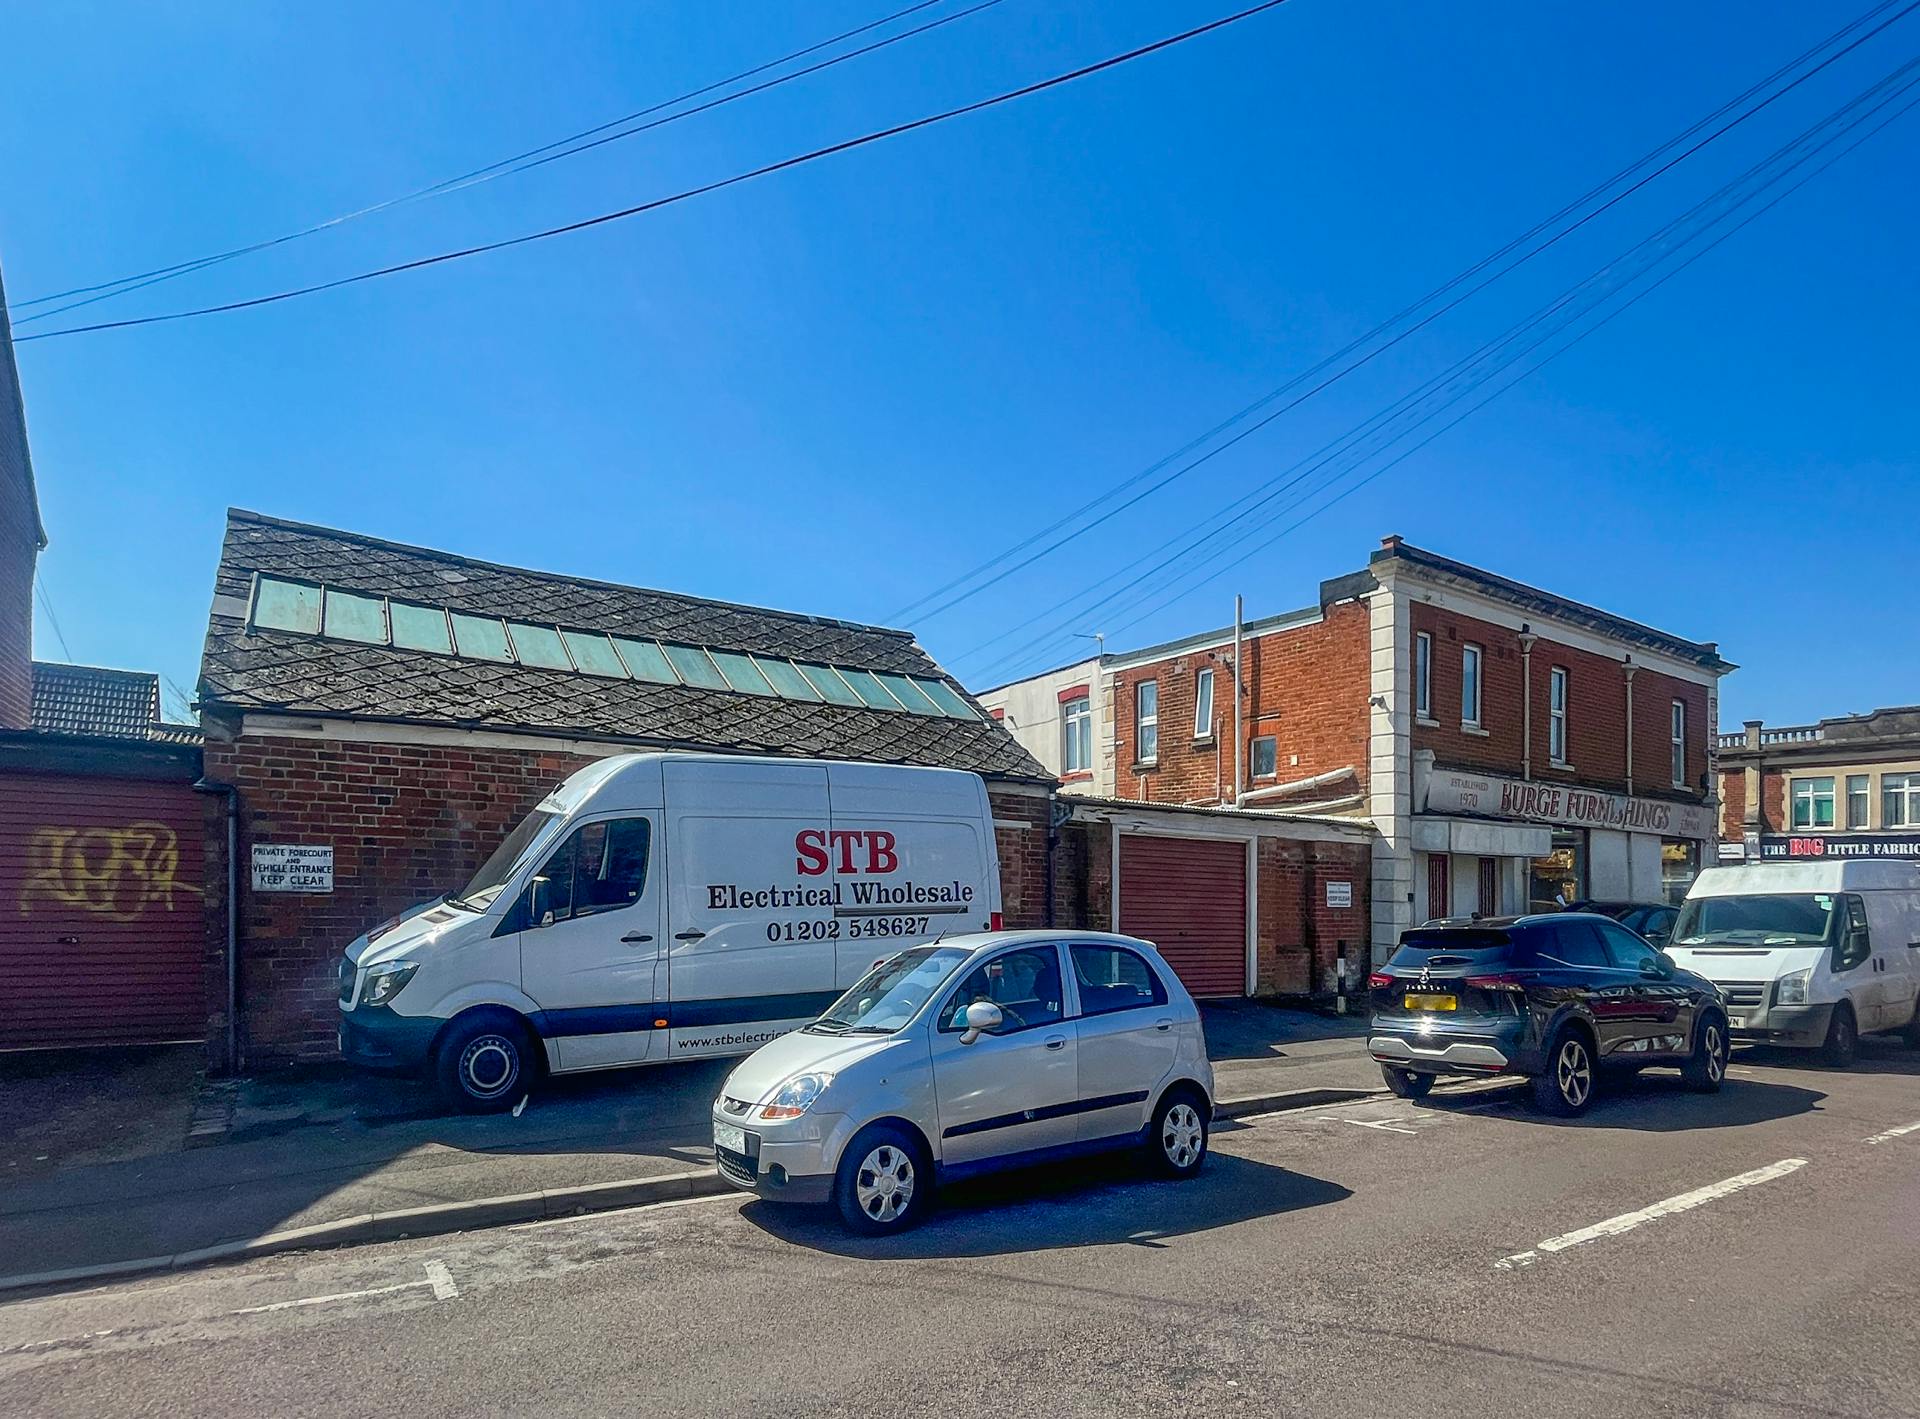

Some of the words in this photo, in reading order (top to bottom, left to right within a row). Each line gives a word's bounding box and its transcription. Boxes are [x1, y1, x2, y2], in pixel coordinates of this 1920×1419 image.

[1460, 793, 1478, 807] 1970
[1501, 783, 1561, 817] BURGE
[253, 848, 285, 856] PRIVATE
[289, 849, 332, 857] FORECOURT
[795, 829, 899, 876] STB
[1763, 845, 1787, 855] THE
[1789, 839, 1824, 856] BIG
[1827, 844, 1870, 855] LITTLE
[1873, 843, 1920, 855] FABRIC
[253, 863, 287, 873] VEHICLE
[290, 865, 332, 874] ENTRANCE
[261, 875, 285, 885] KEEP
[290, 876, 324, 885] CLEAR
[707, 883, 843, 909] Electrical
[851, 881, 974, 904] Wholesale
[766, 919, 841, 942] 01202
[849, 916, 930, 938] 548627
[678, 1028, 792, 1049] www.stbelectric
